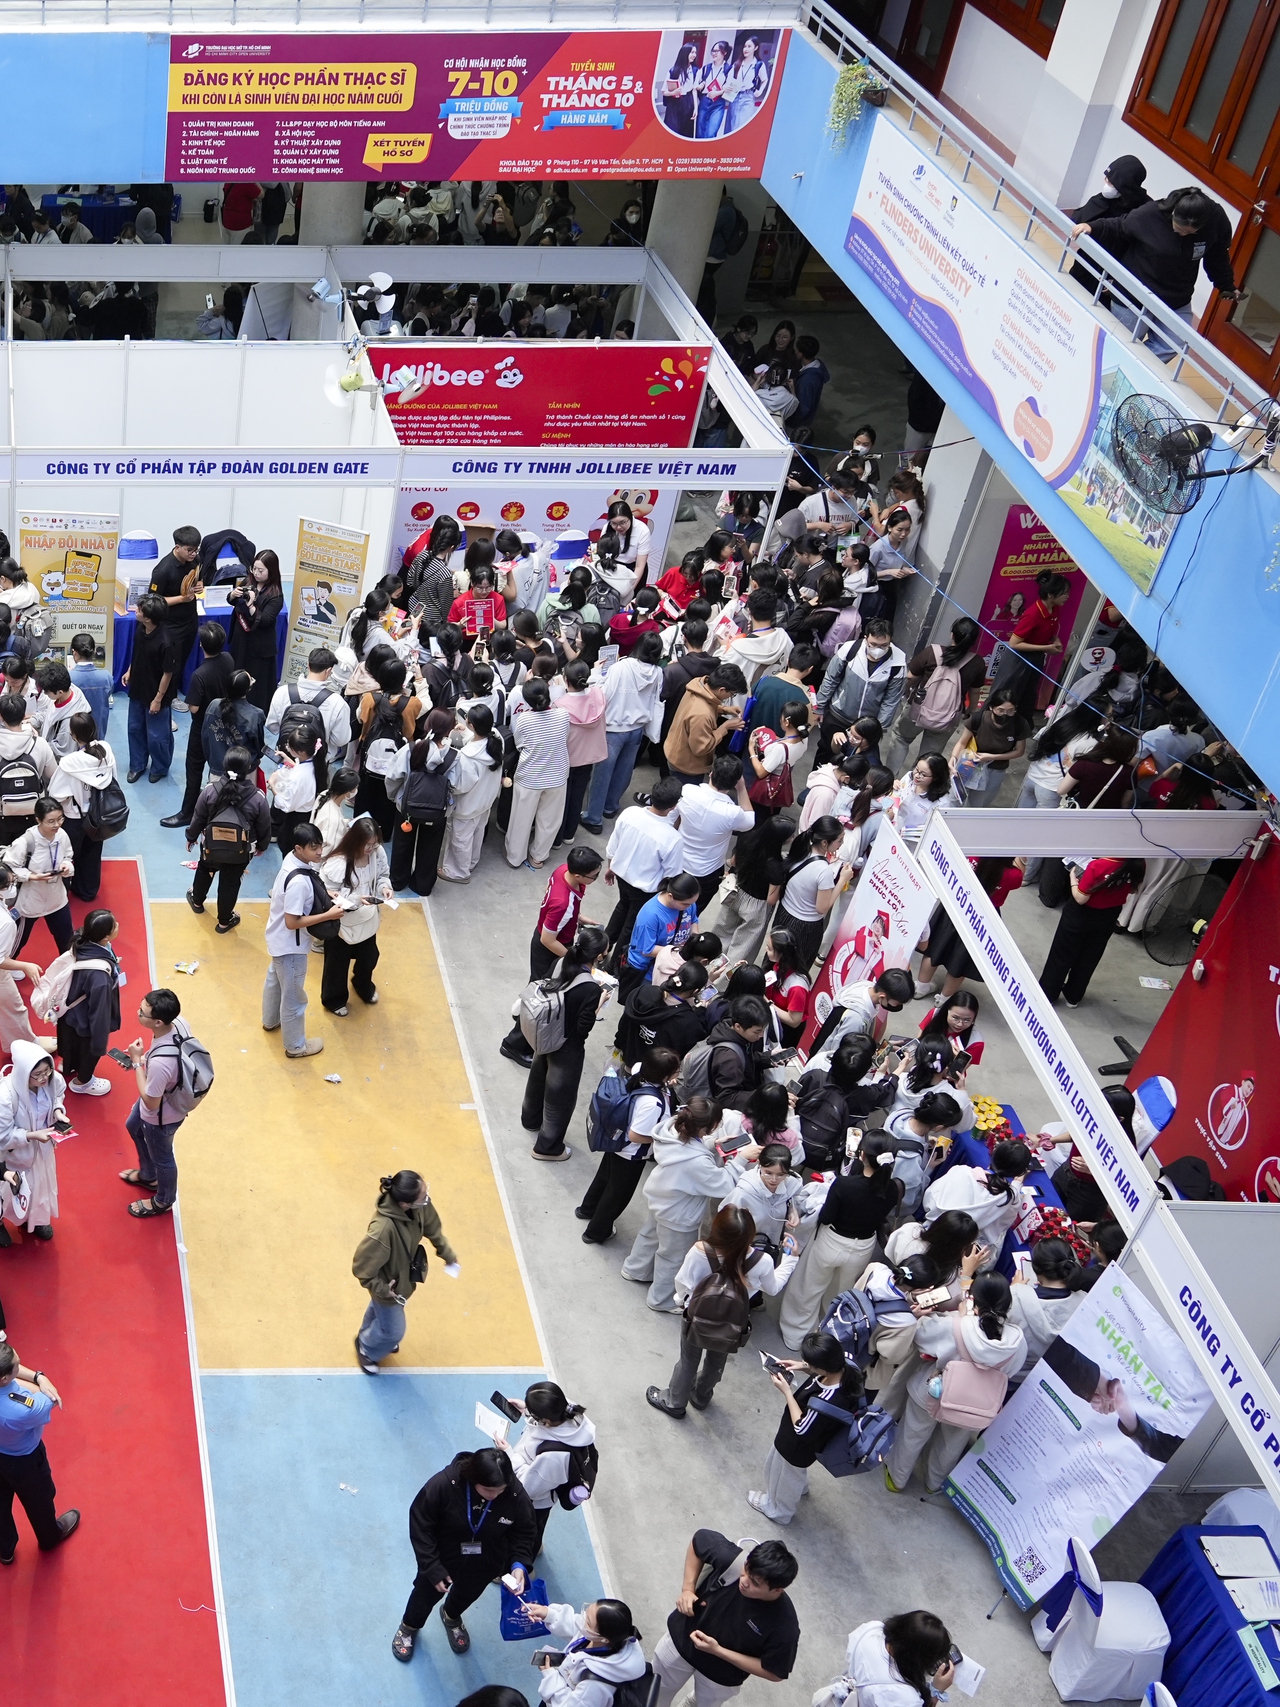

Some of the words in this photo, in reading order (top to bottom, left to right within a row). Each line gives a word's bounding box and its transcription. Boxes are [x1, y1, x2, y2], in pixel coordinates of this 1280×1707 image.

[444, 59, 453, 68] CƠ
[454, 58, 468, 70] HỘI
[469, 57, 490, 70] NHẬN
[491, 59, 505, 70] HỌC
[507, 55, 527, 68] BỔNG
[571, 59, 594, 71] TUYỂN
[597, 62, 616, 71] SINH
[183, 69, 229, 86] ĐĂNG
[232, 69, 255, 86] KÝ
[259, 72, 290, 90] HỌC
[294, 67, 339, 86] PHẦN
[343, 72, 387, 90] THẠC
[390, 69, 407, 86] SĨ
[547, 73, 617, 91] THÁNG
[621, 76, 634, 90] 5
[634, 81, 644, 93] &
[182, 93, 200, 104] KHI
[202, 91, 226, 104] CÒN
[230, 91, 241, 104] LÀ
[244, 93, 271, 104] SINH
[275, 91, 300, 104] VIÊN
[302, 93, 320, 106] ĐẠI
[322, 93, 345, 106] HỌC
[348, 91, 374, 104] NĂM
[377, 90, 403, 104] CUỐI
[454, 102, 481, 114] TRIỆU
[484, 99, 509, 111] ĐỒNG
[540, 91, 610, 108] THÁNG
[615, 94, 635, 107] 10
[560, 113, 586, 124] HÀNG
[588, 113, 609, 124] NĂM
[373, 139, 391, 147] XÉT
[393, 137, 425, 147] TUYỂN
[383, 148, 397, 157] HỒ
[878, 171, 893, 191] TUYỂN
[893, 187, 905, 203] SINH
[903, 197, 924, 223] CHƯƠNG
[923, 219, 939, 238] TRÌNH
[937, 232, 951, 253] LIÊN
[950, 245, 962, 263] KẾT
[961, 258, 977, 282] QUỐC
[977, 274, 986, 288] TẾ
[879, 193, 920, 244] FLINDERS
[918, 235, 972, 298] UNIVERSITY
[46, 461, 89, 475] CÔNG
[93, 463, 111, 475] TY
[116, 458, 137, 474] CỔ
[141, 458, 183, 474] PHẦN
[188, 459, 217, 476] TẬP
[222, 459, 264, 474] ĐOÀN
[269, 462, 329, 474] GOLDEN
[333, 462, 370, 474] GATE
[452, 460, 498, 474] CÔNG
[504, 462, 524, 474] TY
[528, 462, 571, 474] TNHH
[576, 462, 652, 474] JOLLIBEE
[658, 460, 694, 477] VIỆT
[697, 463, 737, 476] NAM
[300, 549, 333, 565] GOLDEN
[333, 557, 361, 572] STARS
[897, 854, 909, 874] LOTTE
[909, 872, 922, 892] MART
[930, 840, 950, 877] CÔNG
[947, 870, 959, 891] TY
[956, 886, 971, 909] CỔ
[965, 902, 987, 943] PHẦN
[984, 936, 1010, 983] TRUNG
[1008, 976, 1028, 1013] TÂM
[1024, 1006, 1056, 1066] THƯƠNG
[1054, 1060, 1074, 1096] MẠI
[1070, 1090, 1099, 1139] LOTTE
[1095, 1133, 1118, 1172] VIỆT
[1115, 1167, 1140, 1213] NAM
[1095, 1315, 1144, 1374] NHÂN
[1179, 1285, 1220, 1357] CÔNG
[1220, 1354, 1243, 1389] TY
[1240, 1392, 1271, 1432] CỔ
